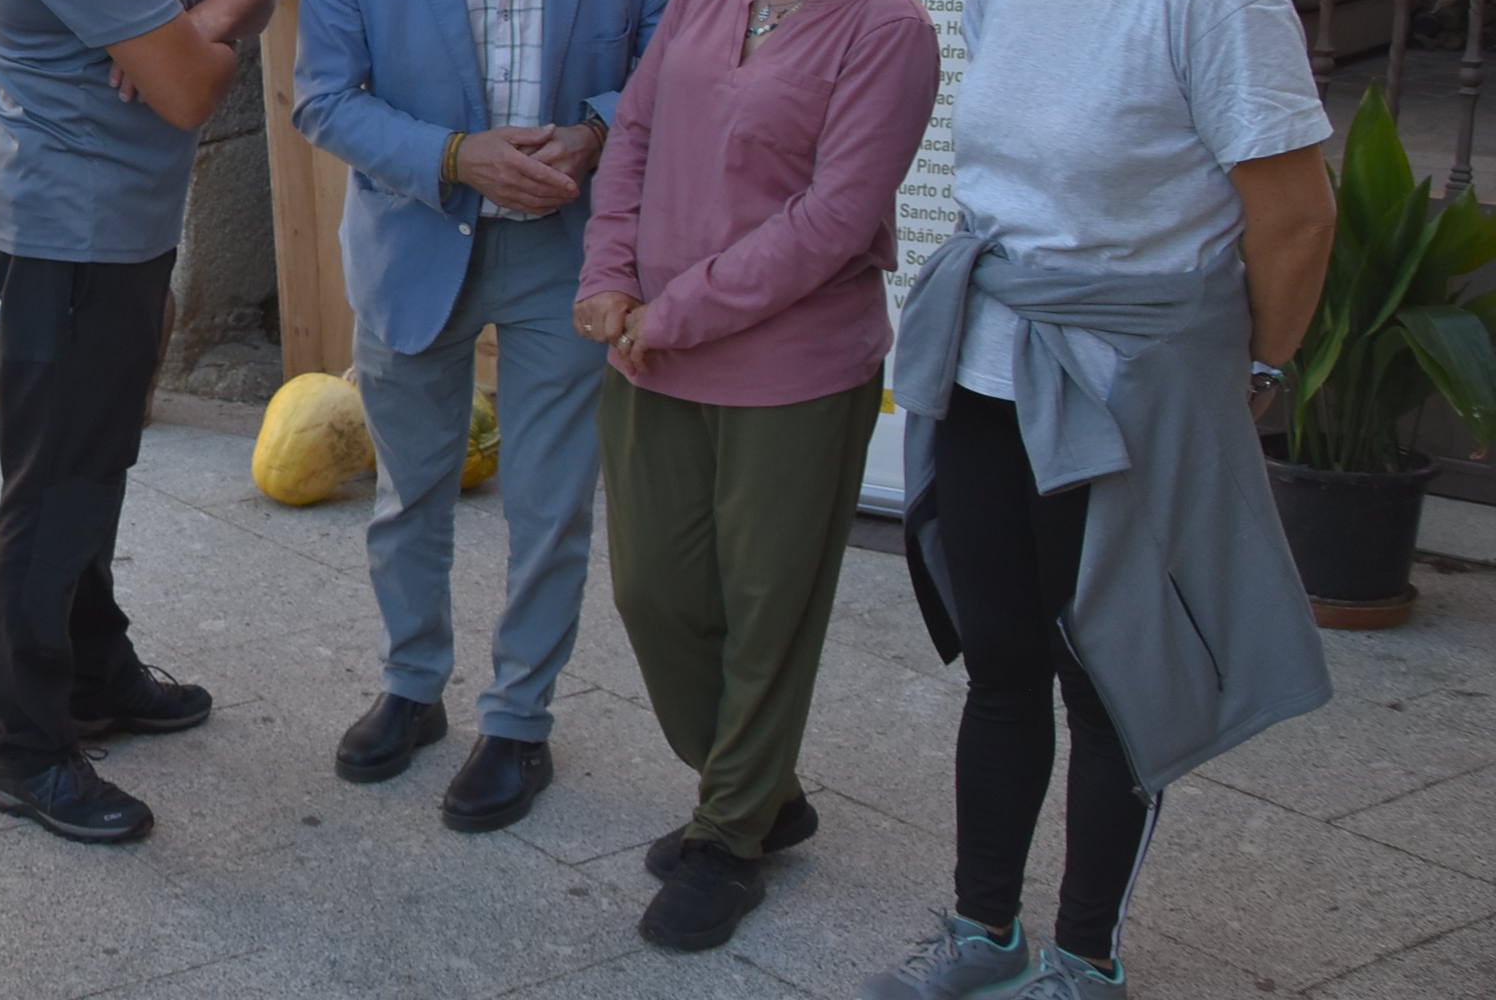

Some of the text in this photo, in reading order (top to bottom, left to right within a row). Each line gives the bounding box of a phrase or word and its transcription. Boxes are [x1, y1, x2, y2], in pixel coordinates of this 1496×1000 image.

[898, 183, 952, 199] uerto d
[900, 203, 957, 222] Sancho
